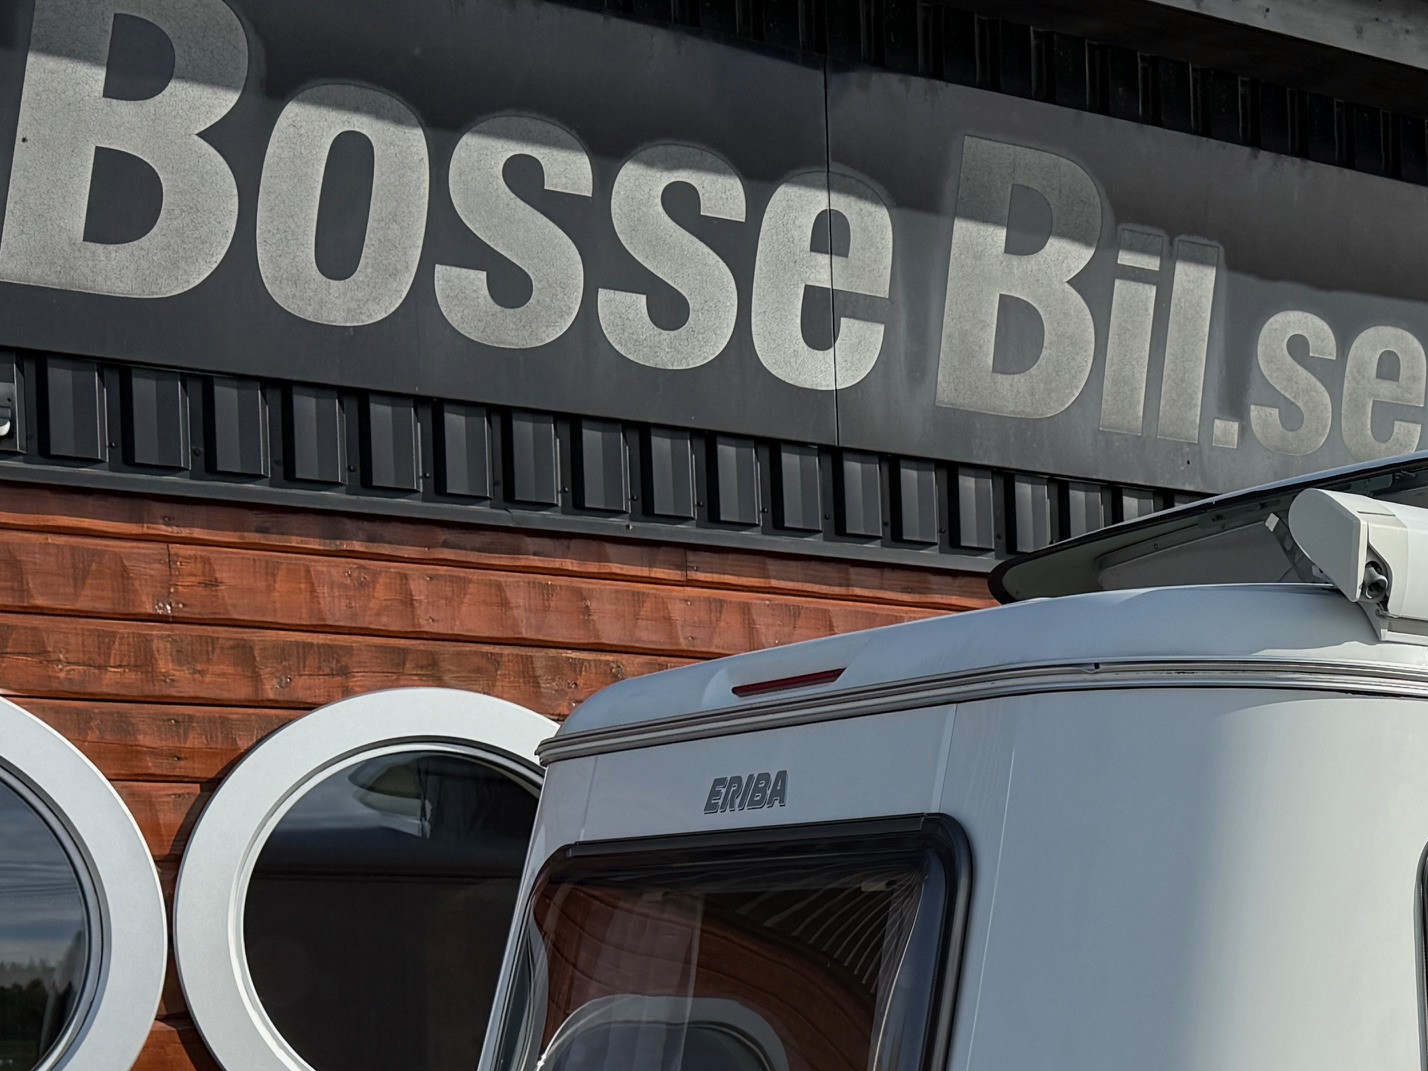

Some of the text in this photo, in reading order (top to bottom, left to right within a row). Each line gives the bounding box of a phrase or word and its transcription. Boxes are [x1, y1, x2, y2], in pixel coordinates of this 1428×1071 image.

[0, 0, 1428, 459] Bosse Bil.se
[703, 770, 788, 814] ERIBA
